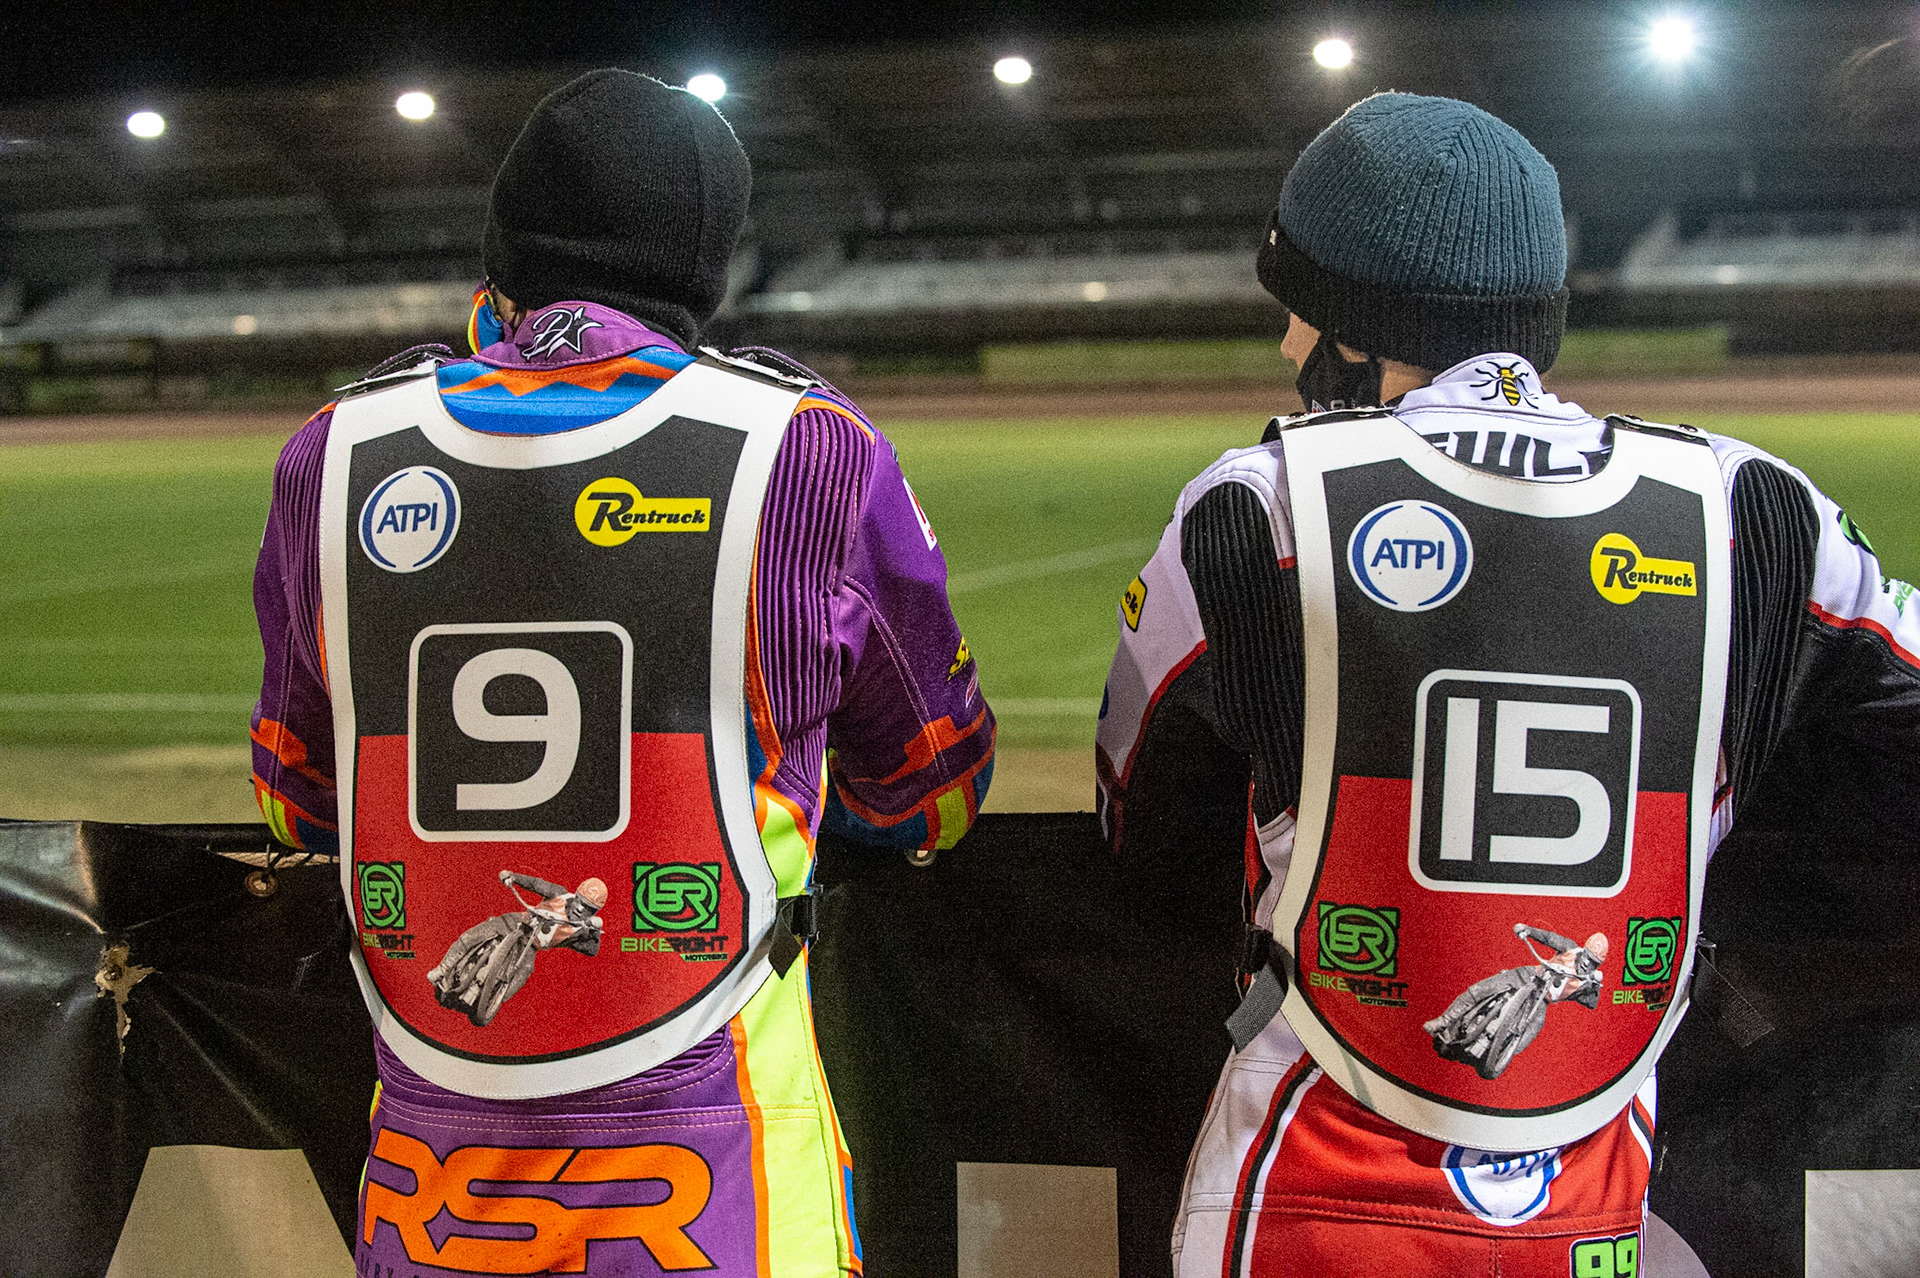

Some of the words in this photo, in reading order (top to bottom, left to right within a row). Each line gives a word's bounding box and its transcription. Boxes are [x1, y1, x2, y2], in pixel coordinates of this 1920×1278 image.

[376, 502, 438, 534] ATPI
[587, 492, 705, 532] Rentruck
[1370, 538, 1444, 570] ATPI
[1600, 546, 1692, 590] Rentruck
[452, 648, 581, 811] 9
[1440, 696, 1612, 866] 15
[362, 1126, 719, 1276] RSR
